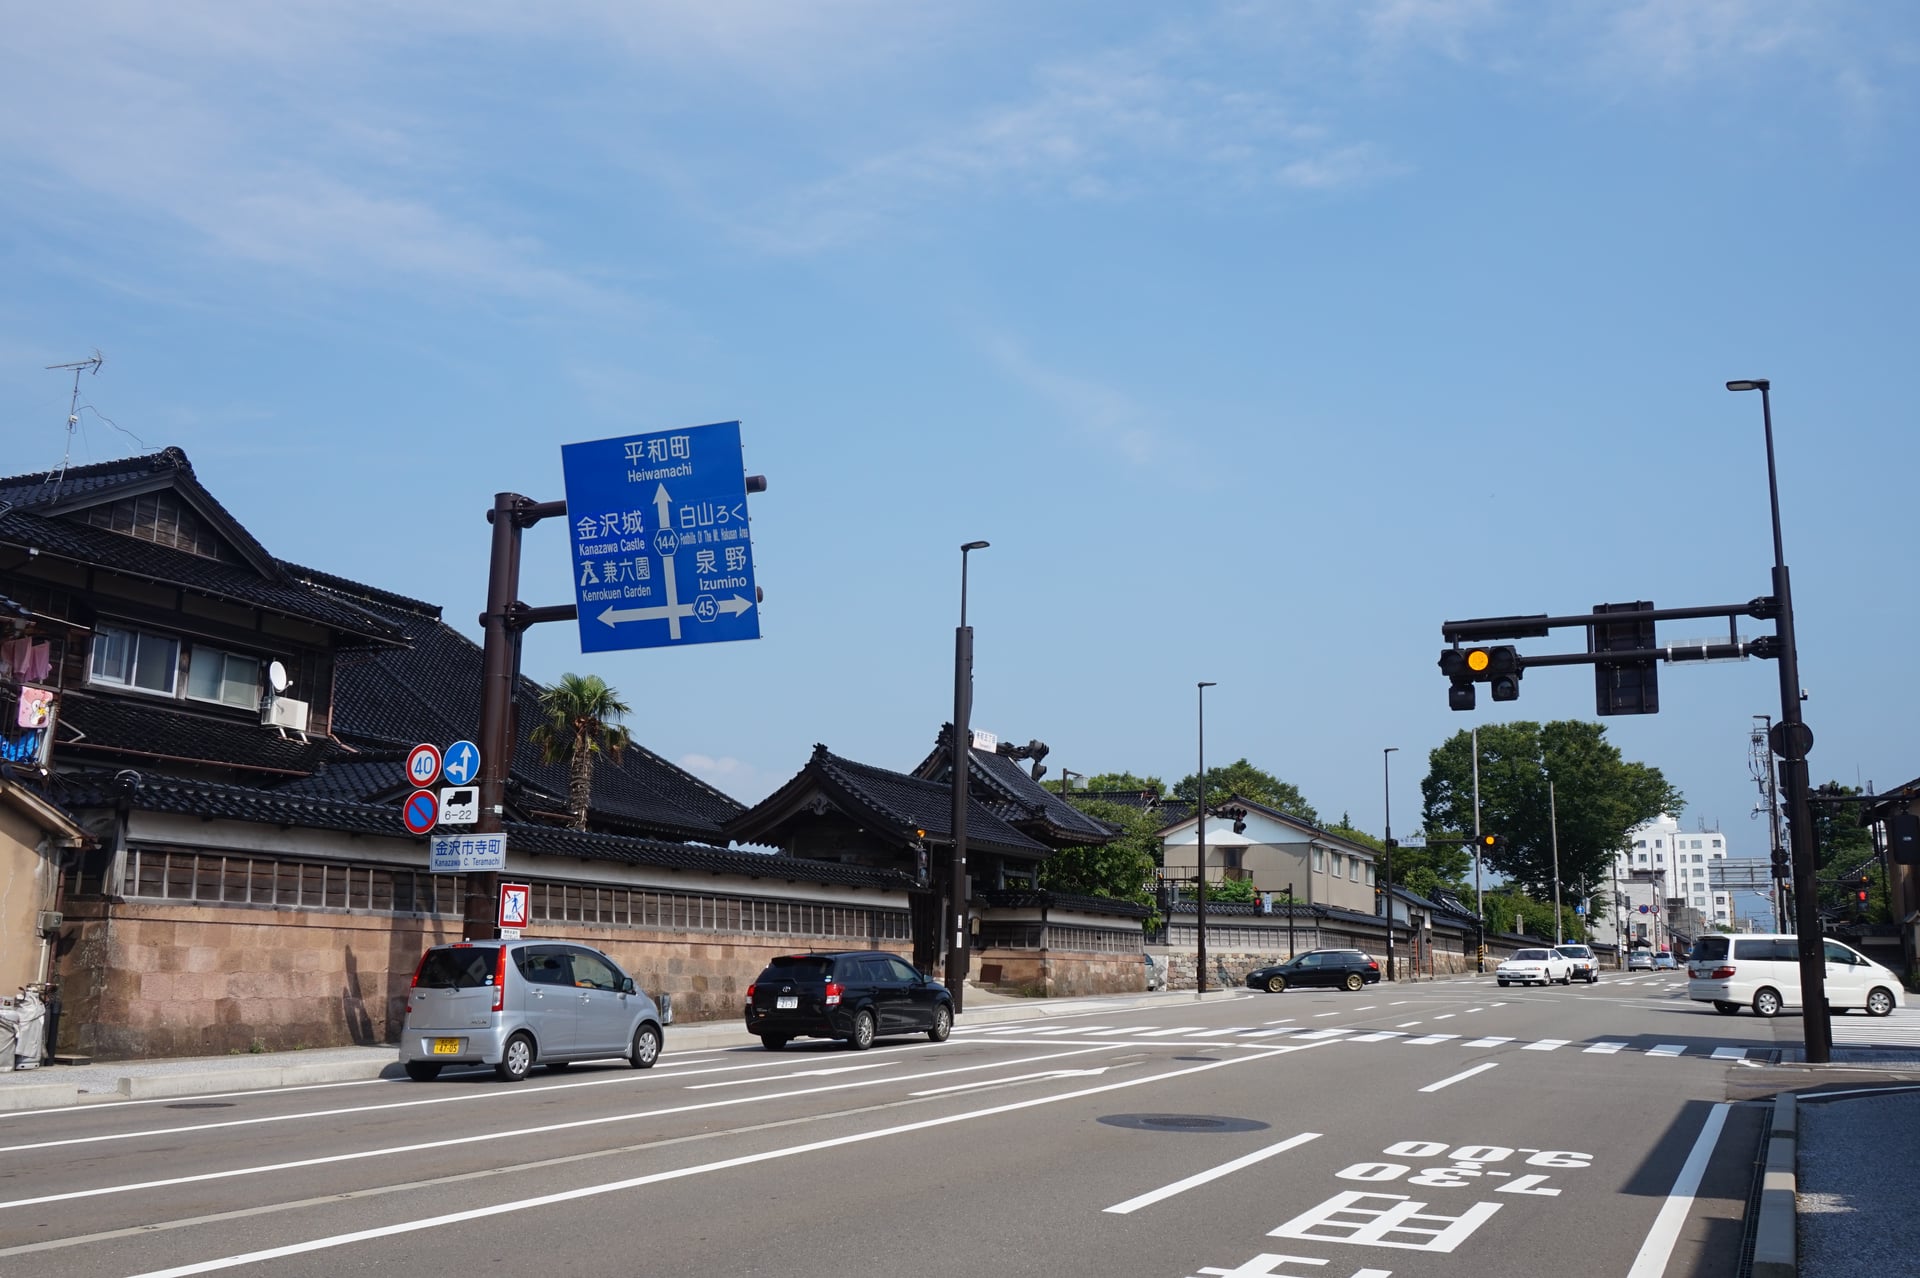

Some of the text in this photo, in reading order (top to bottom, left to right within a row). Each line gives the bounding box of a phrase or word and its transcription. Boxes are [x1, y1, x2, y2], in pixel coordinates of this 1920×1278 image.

[624, 435, 690, 466] 平和町
[627, 462, 692, 483] Heiwamachi
[576, 509, 644, 540] 金沢城
[680, 501, 745, 529] 白山ろく
[578, 537, 645, 556] Kanazawa Castle
[657, 535, 676, 550] 144
[602, 556, 651, 584] 兼六園
[696, 546, 747, 575] 泉野
[699, 575, 747, 591] Izumino
[582, 584, 652, 602] Kenrokuen Garden
[697, 600, 714, 616] 45
[413, 756, 433, 775] 40
[444, 810, 472, 821] 6-22
[435, 839, 502, 856] 金沢市寺町
[434, 858, 460, 868] Kanazawa
[472, 857, 500, 867] Teramachi
